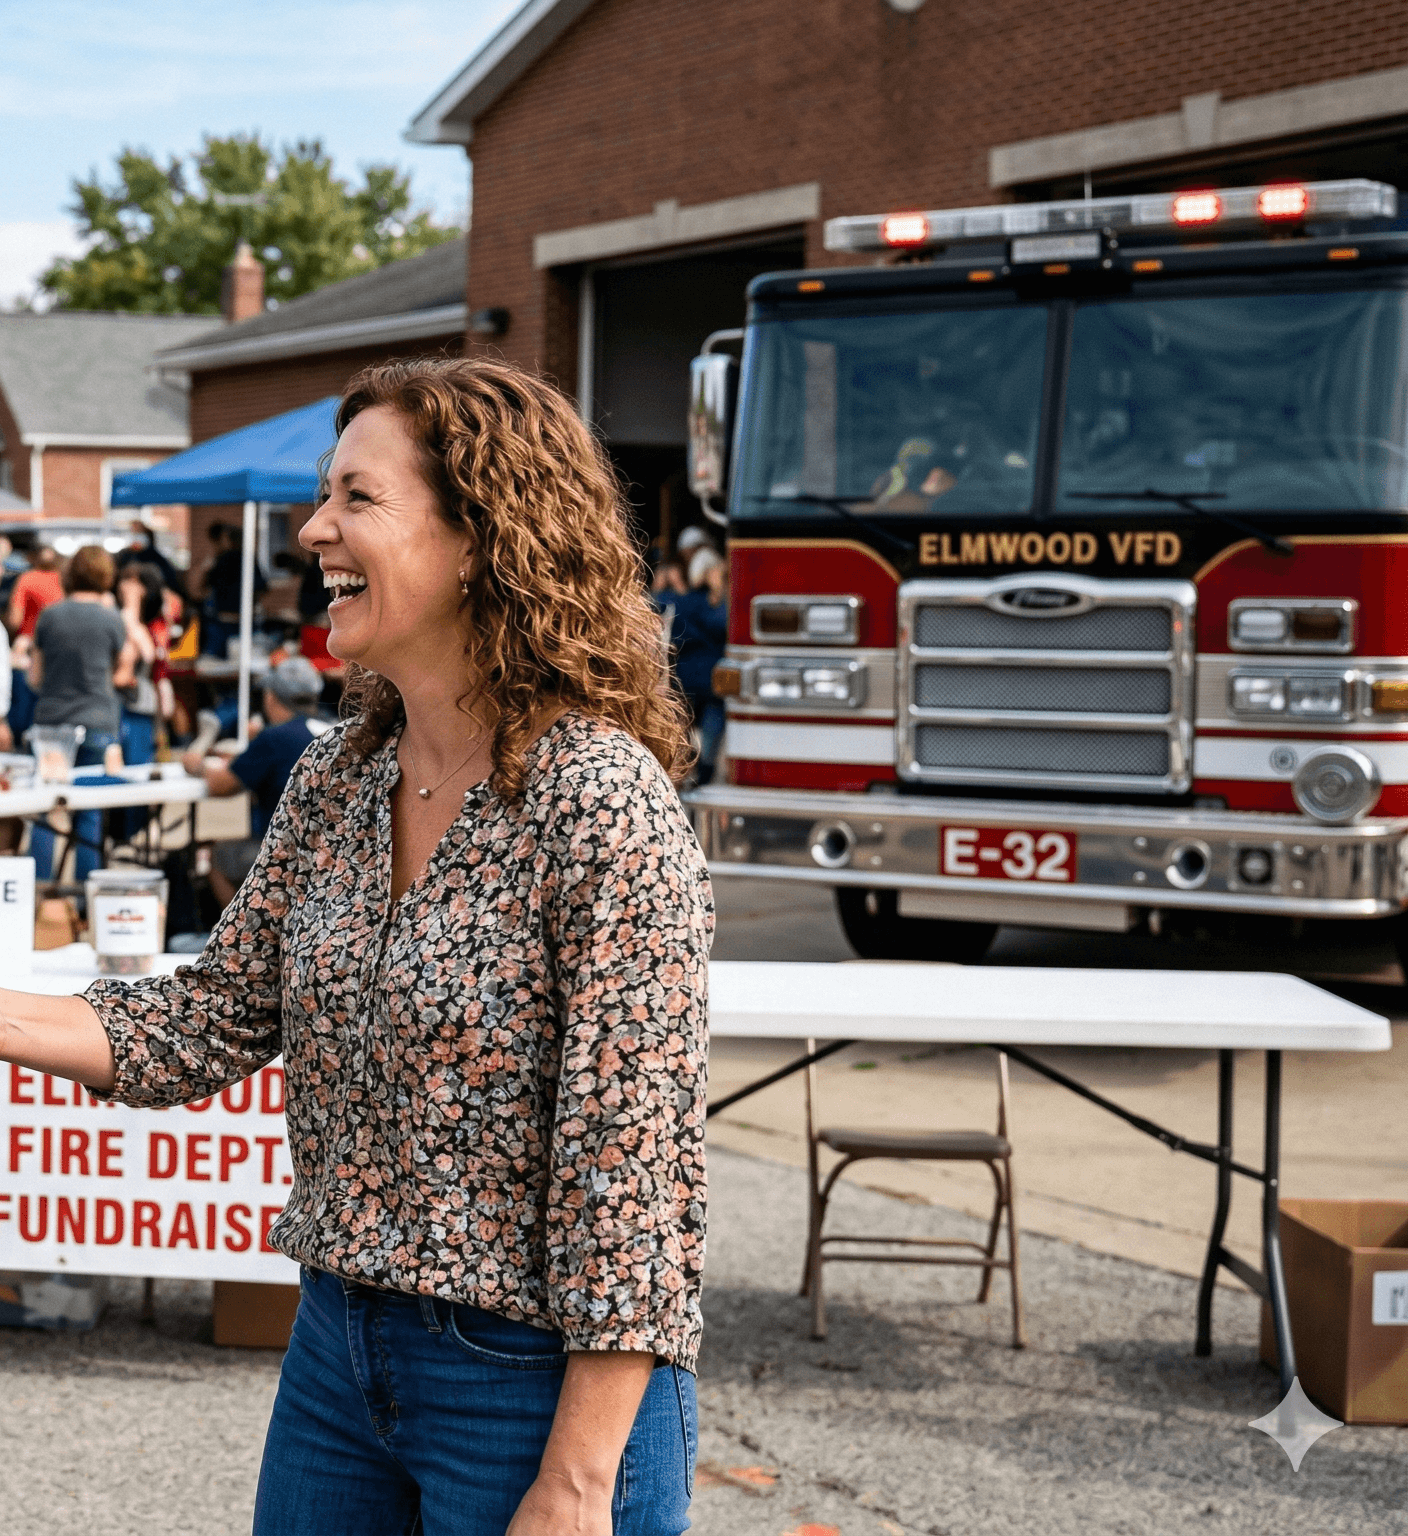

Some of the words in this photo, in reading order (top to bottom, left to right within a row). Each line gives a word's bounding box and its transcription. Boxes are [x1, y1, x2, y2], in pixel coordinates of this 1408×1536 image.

[918, 532, 1098, 564] ELMWOOD
[1108, 531, 1182, 565] VFD
[943, 828, 1070, 881] E-32
[9, 1126, 124, 1177] FIRE
[148, 1132, 293, 1184] DEPT.
